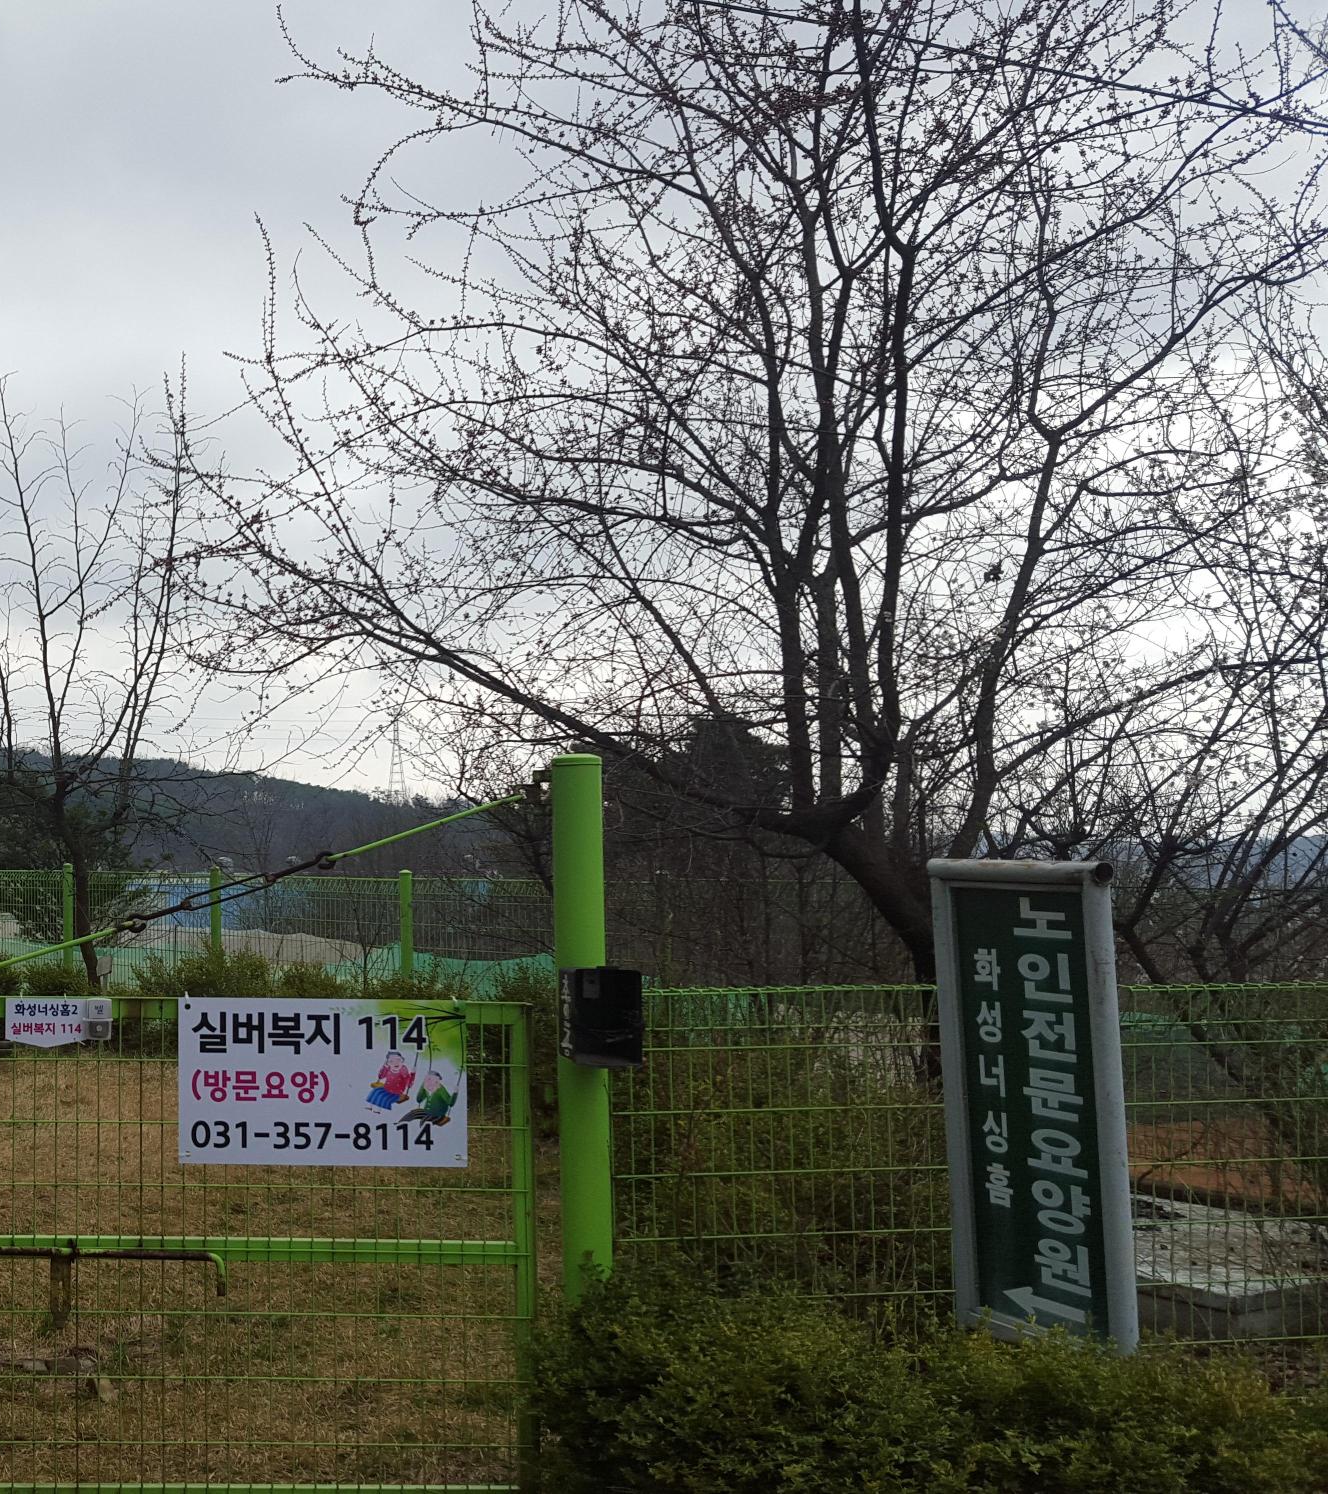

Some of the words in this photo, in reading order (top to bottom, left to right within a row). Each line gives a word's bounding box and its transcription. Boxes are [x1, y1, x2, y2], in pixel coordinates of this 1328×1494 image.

[14, 1003, 78, 1016] 화성너싱홈2
[11, 1022, 56, 1035] 실버복지
[60, 1024, 81, 1034] 114
[191, 1011, 341, 1055] 실버복지
[358, 1016, 427, 1050] 114
[191, 1069, 330, 1103] (방문요양)
[973, 948, 1014, 1208] 화성너싱홈
[1013, 897, 1093, 1298] 노인전문요양원
[191, 1120, 434, 1150] 031-357-8114
